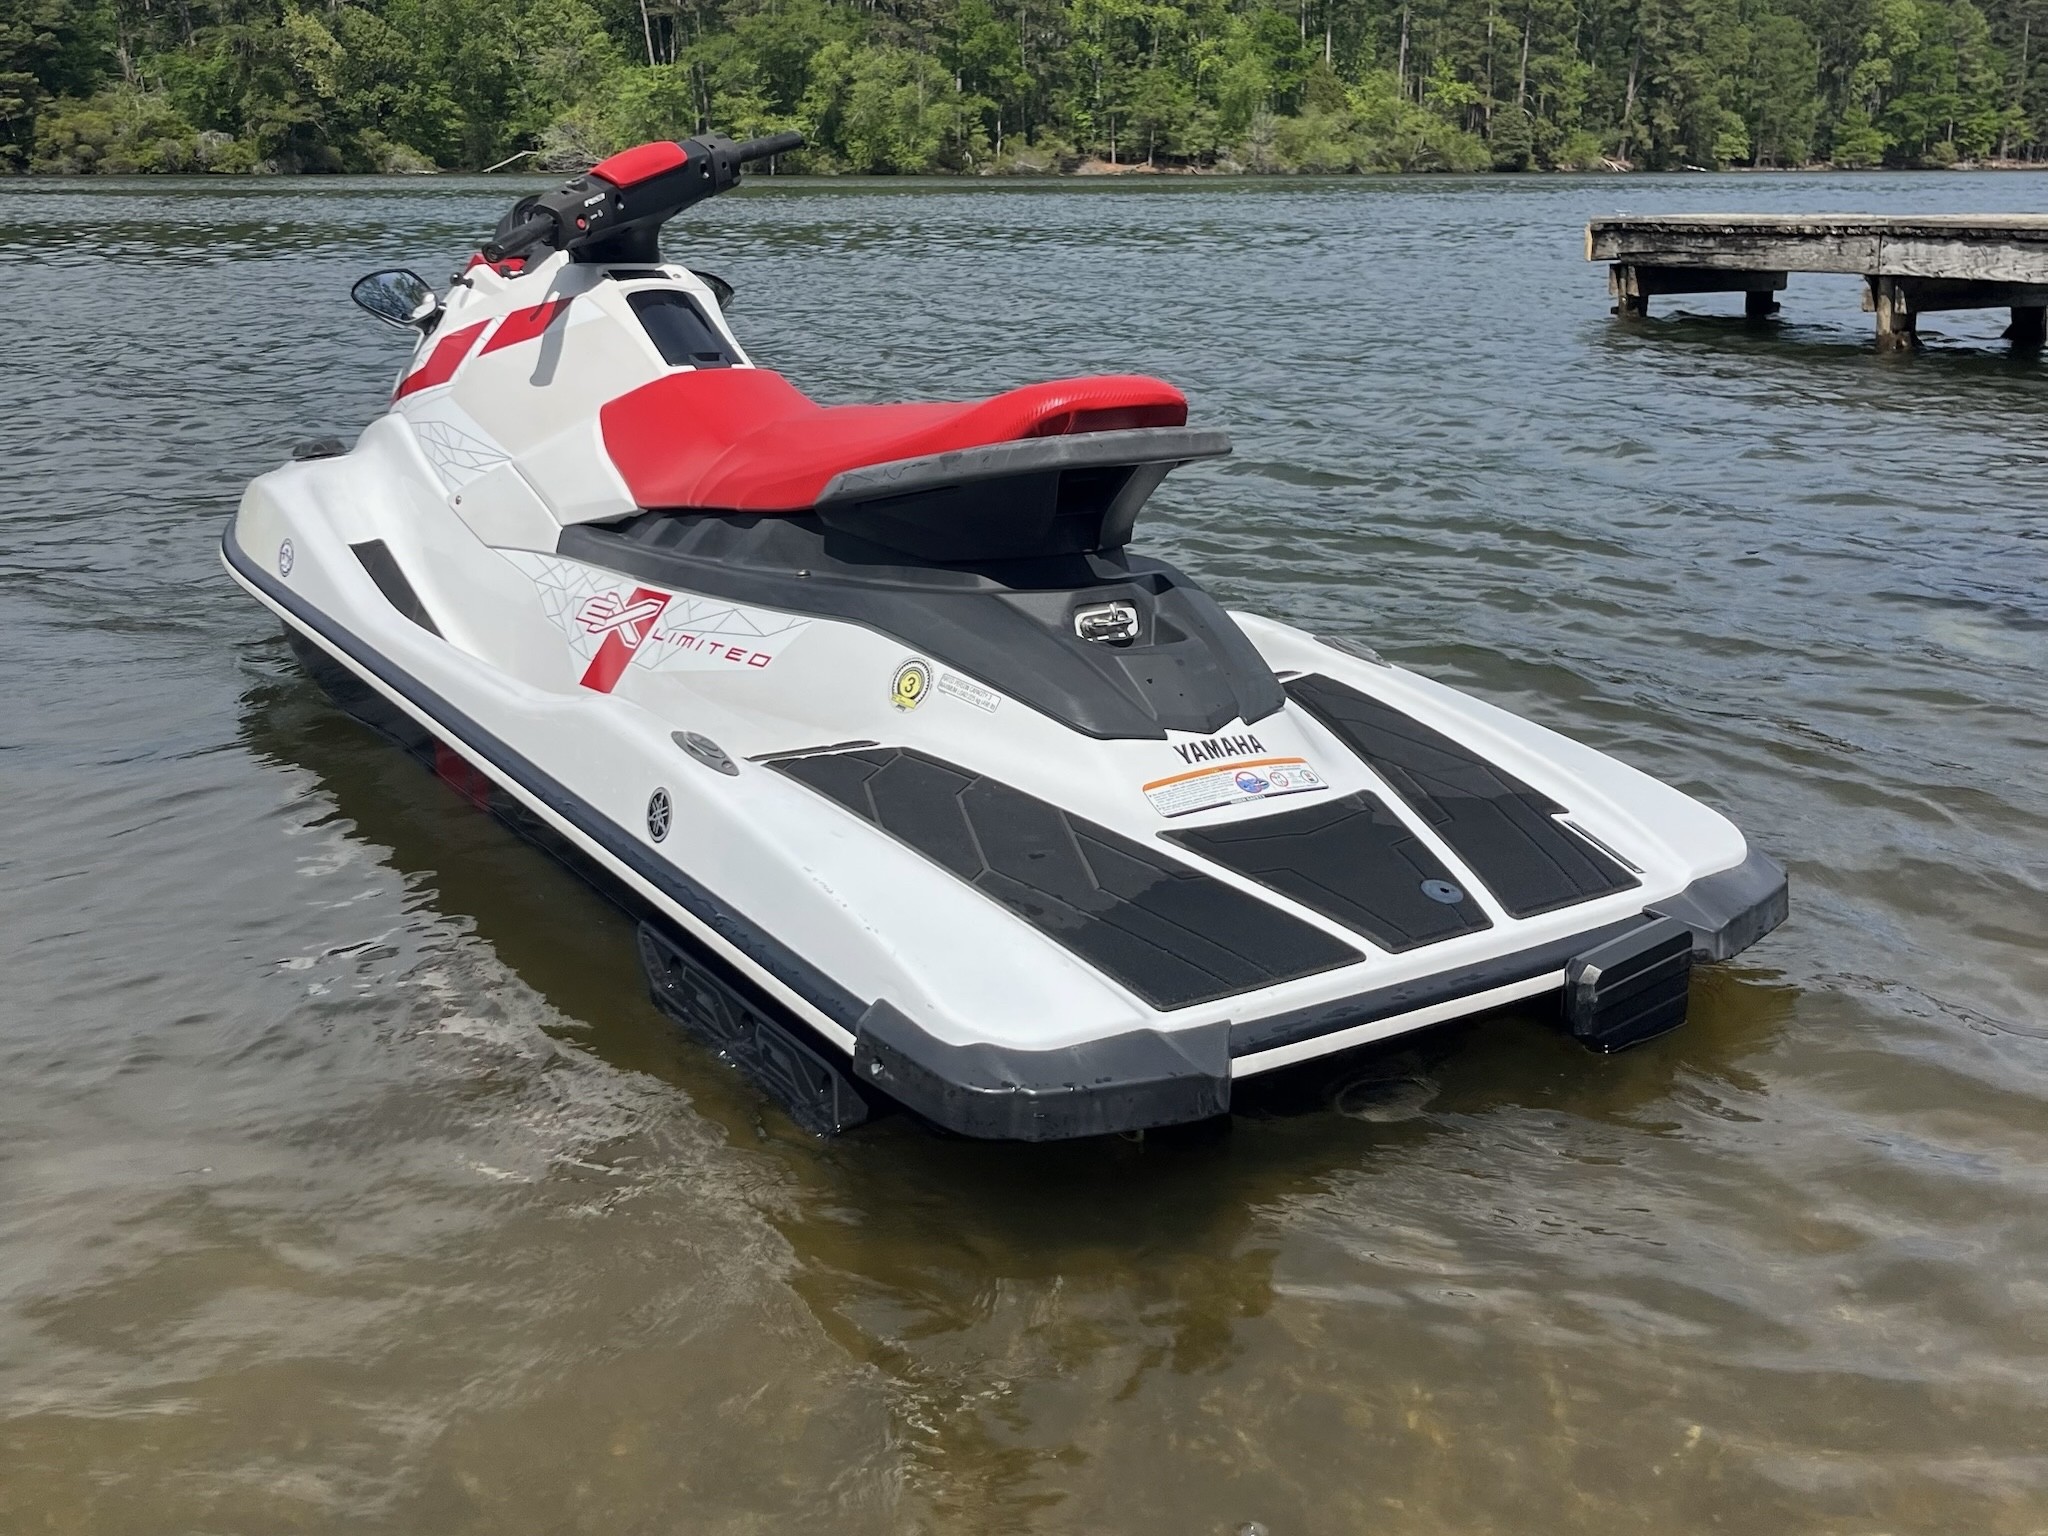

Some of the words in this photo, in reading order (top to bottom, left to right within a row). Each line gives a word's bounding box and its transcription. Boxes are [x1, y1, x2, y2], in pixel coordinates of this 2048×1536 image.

[652, 628, 772, 668] LIMITED
[904, 676, 916, 693] 3
[1172, 734, 1267, 764] YAMAHA
